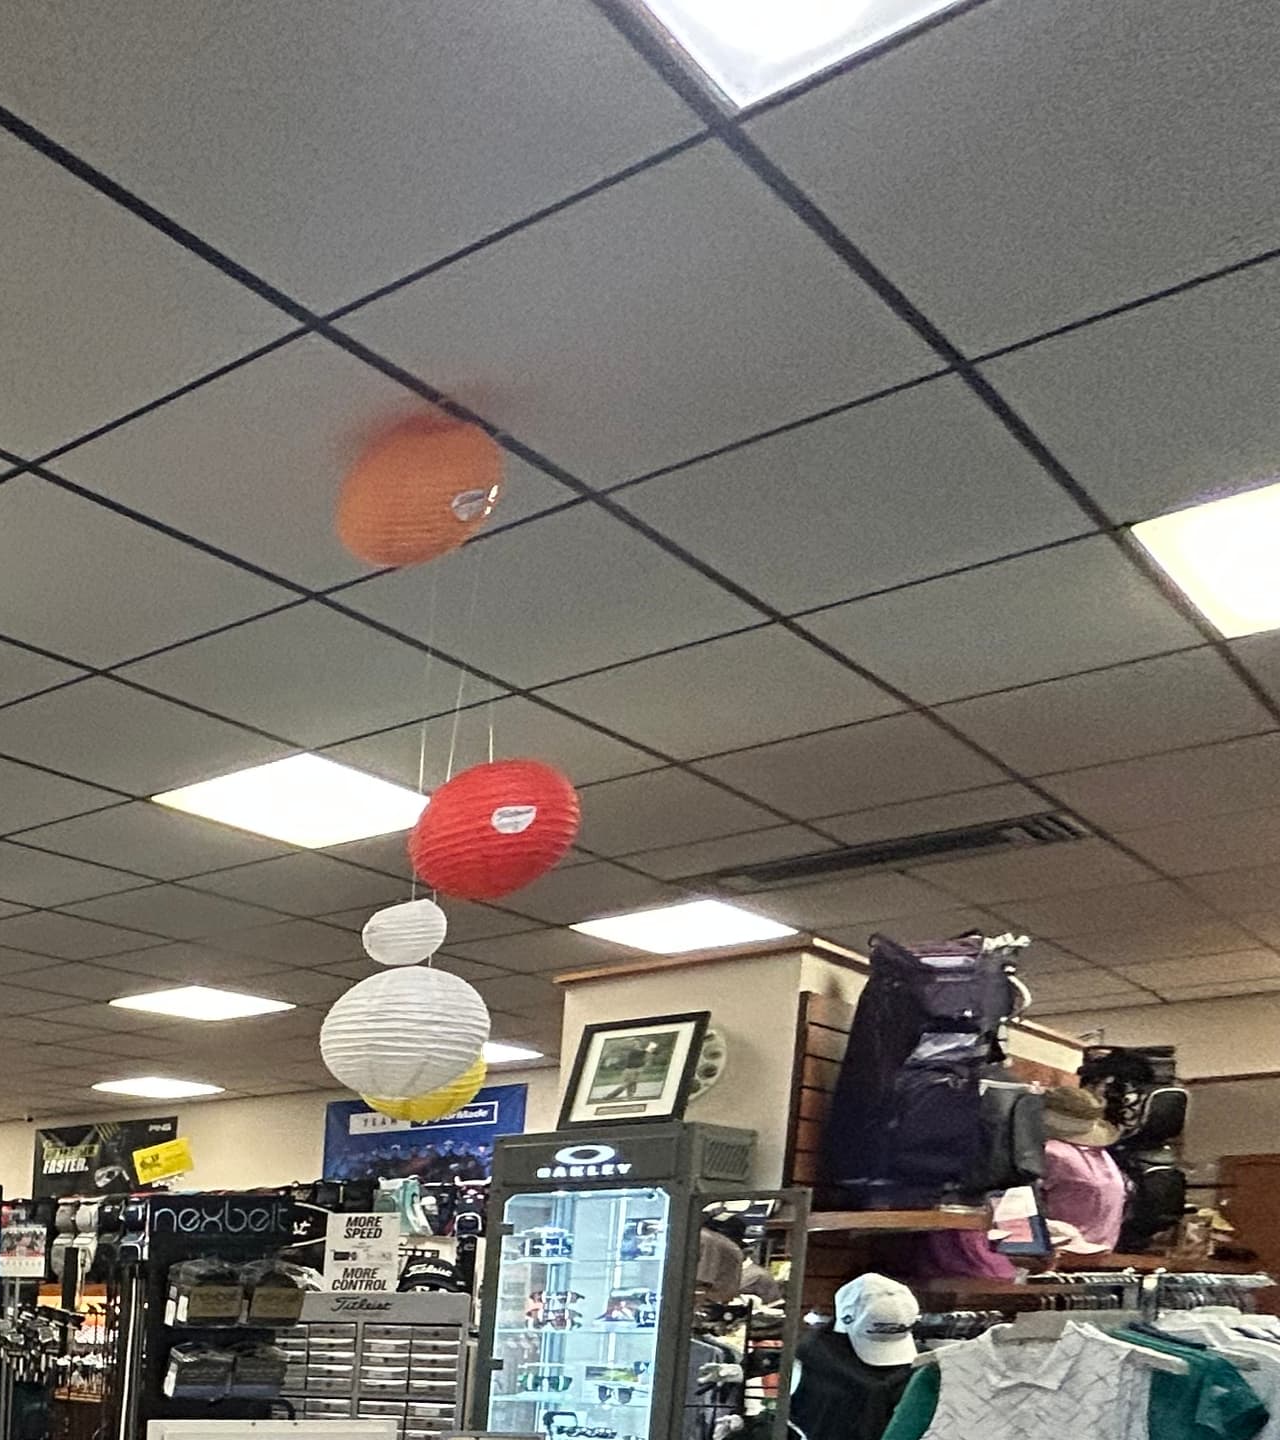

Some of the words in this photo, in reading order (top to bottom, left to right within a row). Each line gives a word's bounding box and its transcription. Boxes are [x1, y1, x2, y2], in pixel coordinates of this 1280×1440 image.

[536, 1163, 633, 1179] OAKLEY
[152, 1201, 289, 1233] nexbelt
[345, 1216, 383, 1228] MORE
[343, 1227, 383, 1240] SPEED
[342, 1267, 378, 1280] MORE
[331, 1279, 388, 1292] CONTROL
